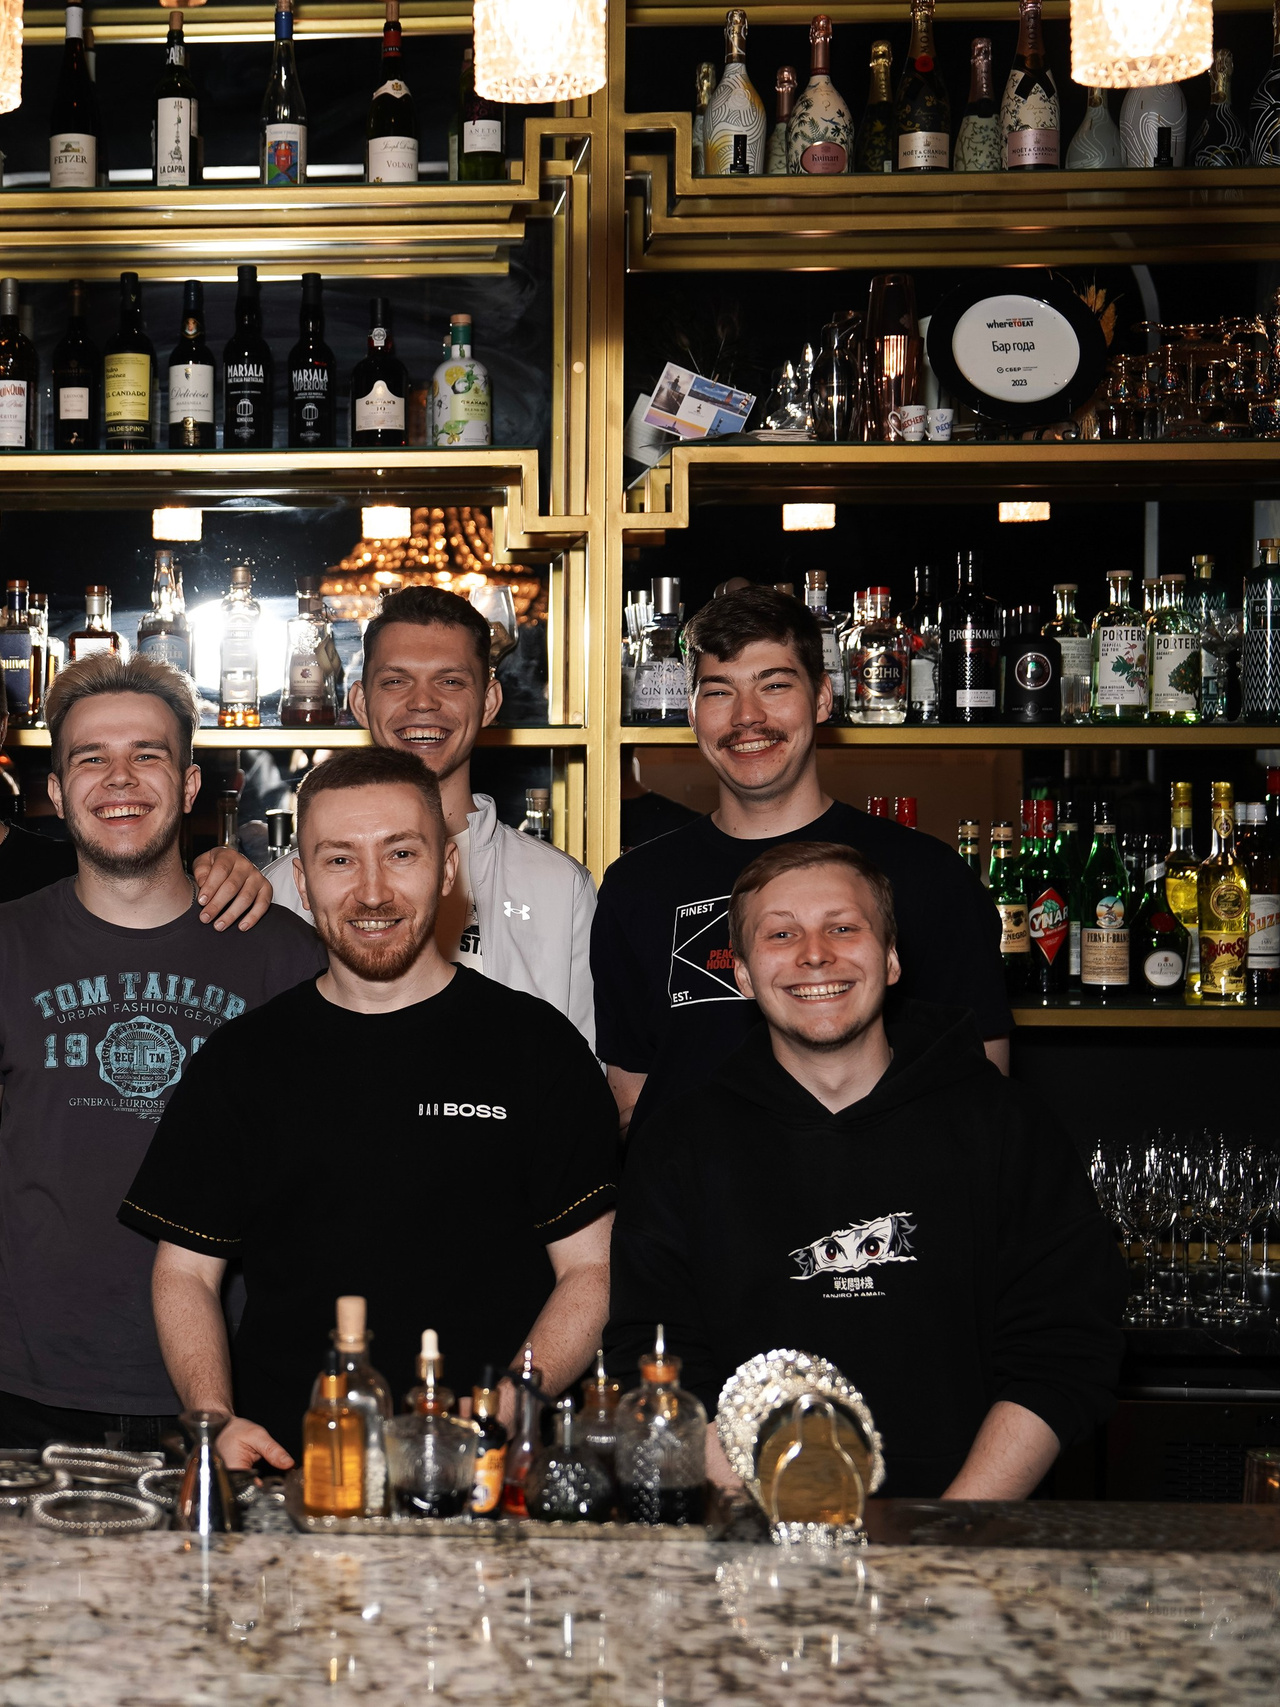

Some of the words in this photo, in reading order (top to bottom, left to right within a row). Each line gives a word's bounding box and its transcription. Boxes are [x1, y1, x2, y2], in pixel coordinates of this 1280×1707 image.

[54, 155, 88, 165] FETZER
[167, 165, 186, 174] CAPRA
[992, 341, 1011, 354] Бар
[1013, 341, 1035, 352] года
[228, 364, 264, 378] MARSALA
[292, 369, 328, 381] MARSALA
[293, 381, 328, 392] SUPERIORE
[171, 387, 209, 400] Deliciosa
[1102, 629, 1145, 641] PORTERS
[1156, 638, 1199, 649] PORTERS
[863, 667, 900, 678] OPIHR
[642, 687, 660, 695] GIN
[665, 687, 688, 695] MAR
[680, 903, 714, 918] FINEST
[1029, 906, 1068, 938] CYNAR
[1087, 932, 1128, 943] FERNET-BRAN
[460, 934, 482, 956] ST
[32, 974, 112, 1020] TOM
[118, 972, 246, 1020] TAILOR
[672, 991, 692, 1003] EST.
[56, 1003, 107, 1024] URBAN
[113, 1002, 178, 1015] FASHION
[184, 1009, 222, 1027] GEAR
[103, 1023, 138, 1070] REGISTERED
[143, 1023, 180, 1072] TRADEMARK
[114, 1053, 134, 1062] REG
[149, 1054, 165, 1062] TM
[69, 1098, 117, 1106] GENERAL
[120, 1098, 165, 1108] PURPOSE
[419, 1104, 438, 1116] BAR
[444, 1103, 507, 1120] BOSS
